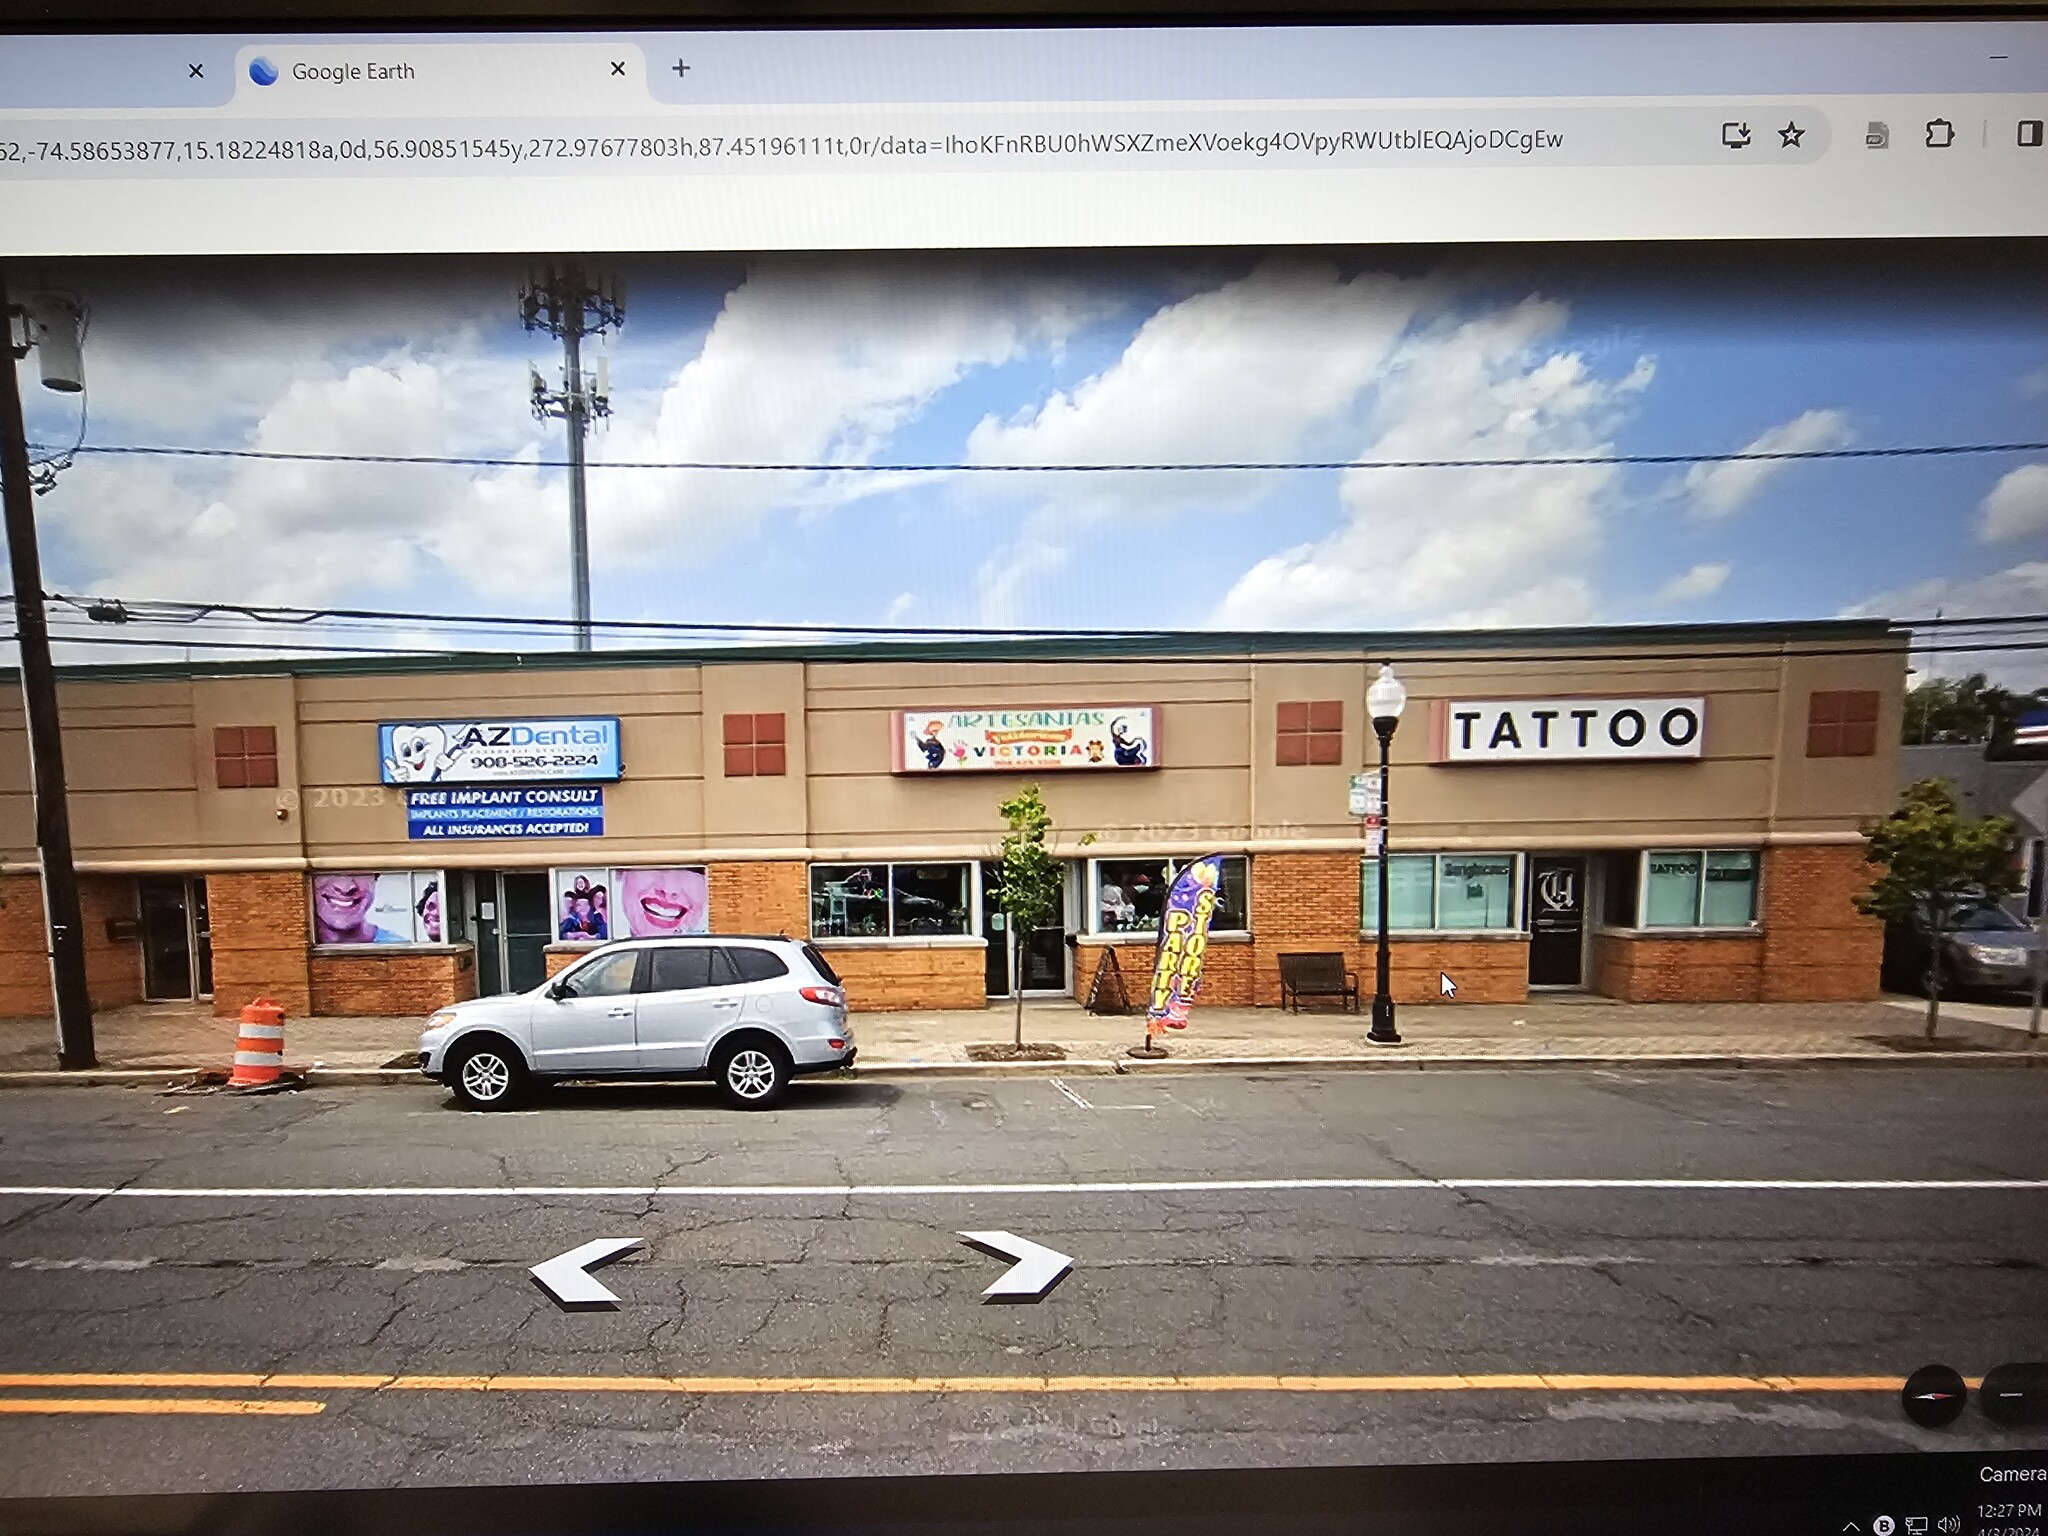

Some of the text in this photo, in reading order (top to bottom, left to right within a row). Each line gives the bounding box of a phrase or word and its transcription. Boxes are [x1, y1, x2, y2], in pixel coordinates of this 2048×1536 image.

[292, 62, 415, 85] Google Earth
[948, 711, 1105, 728] ARTESANIAS
[1454, 706, 1698, 750] TATTOO
[974, 745, 1082, 757] VICTORIA
[410, 792, 446, 805] FREE
[451, 791, 521, 804] IMPLANT
[525, 789, 598, 803] CONSULT
[423, 822, 590, 836] ALL INSURANCES ACCEPTED!
[1179, 891, 1212, 998] STORE
[1153, 911, 1191, 1010] PARTY
[1980, 1466, 2047, 1482] Camera
[1978, 1503, 2042, 1518] 12:27 PM
